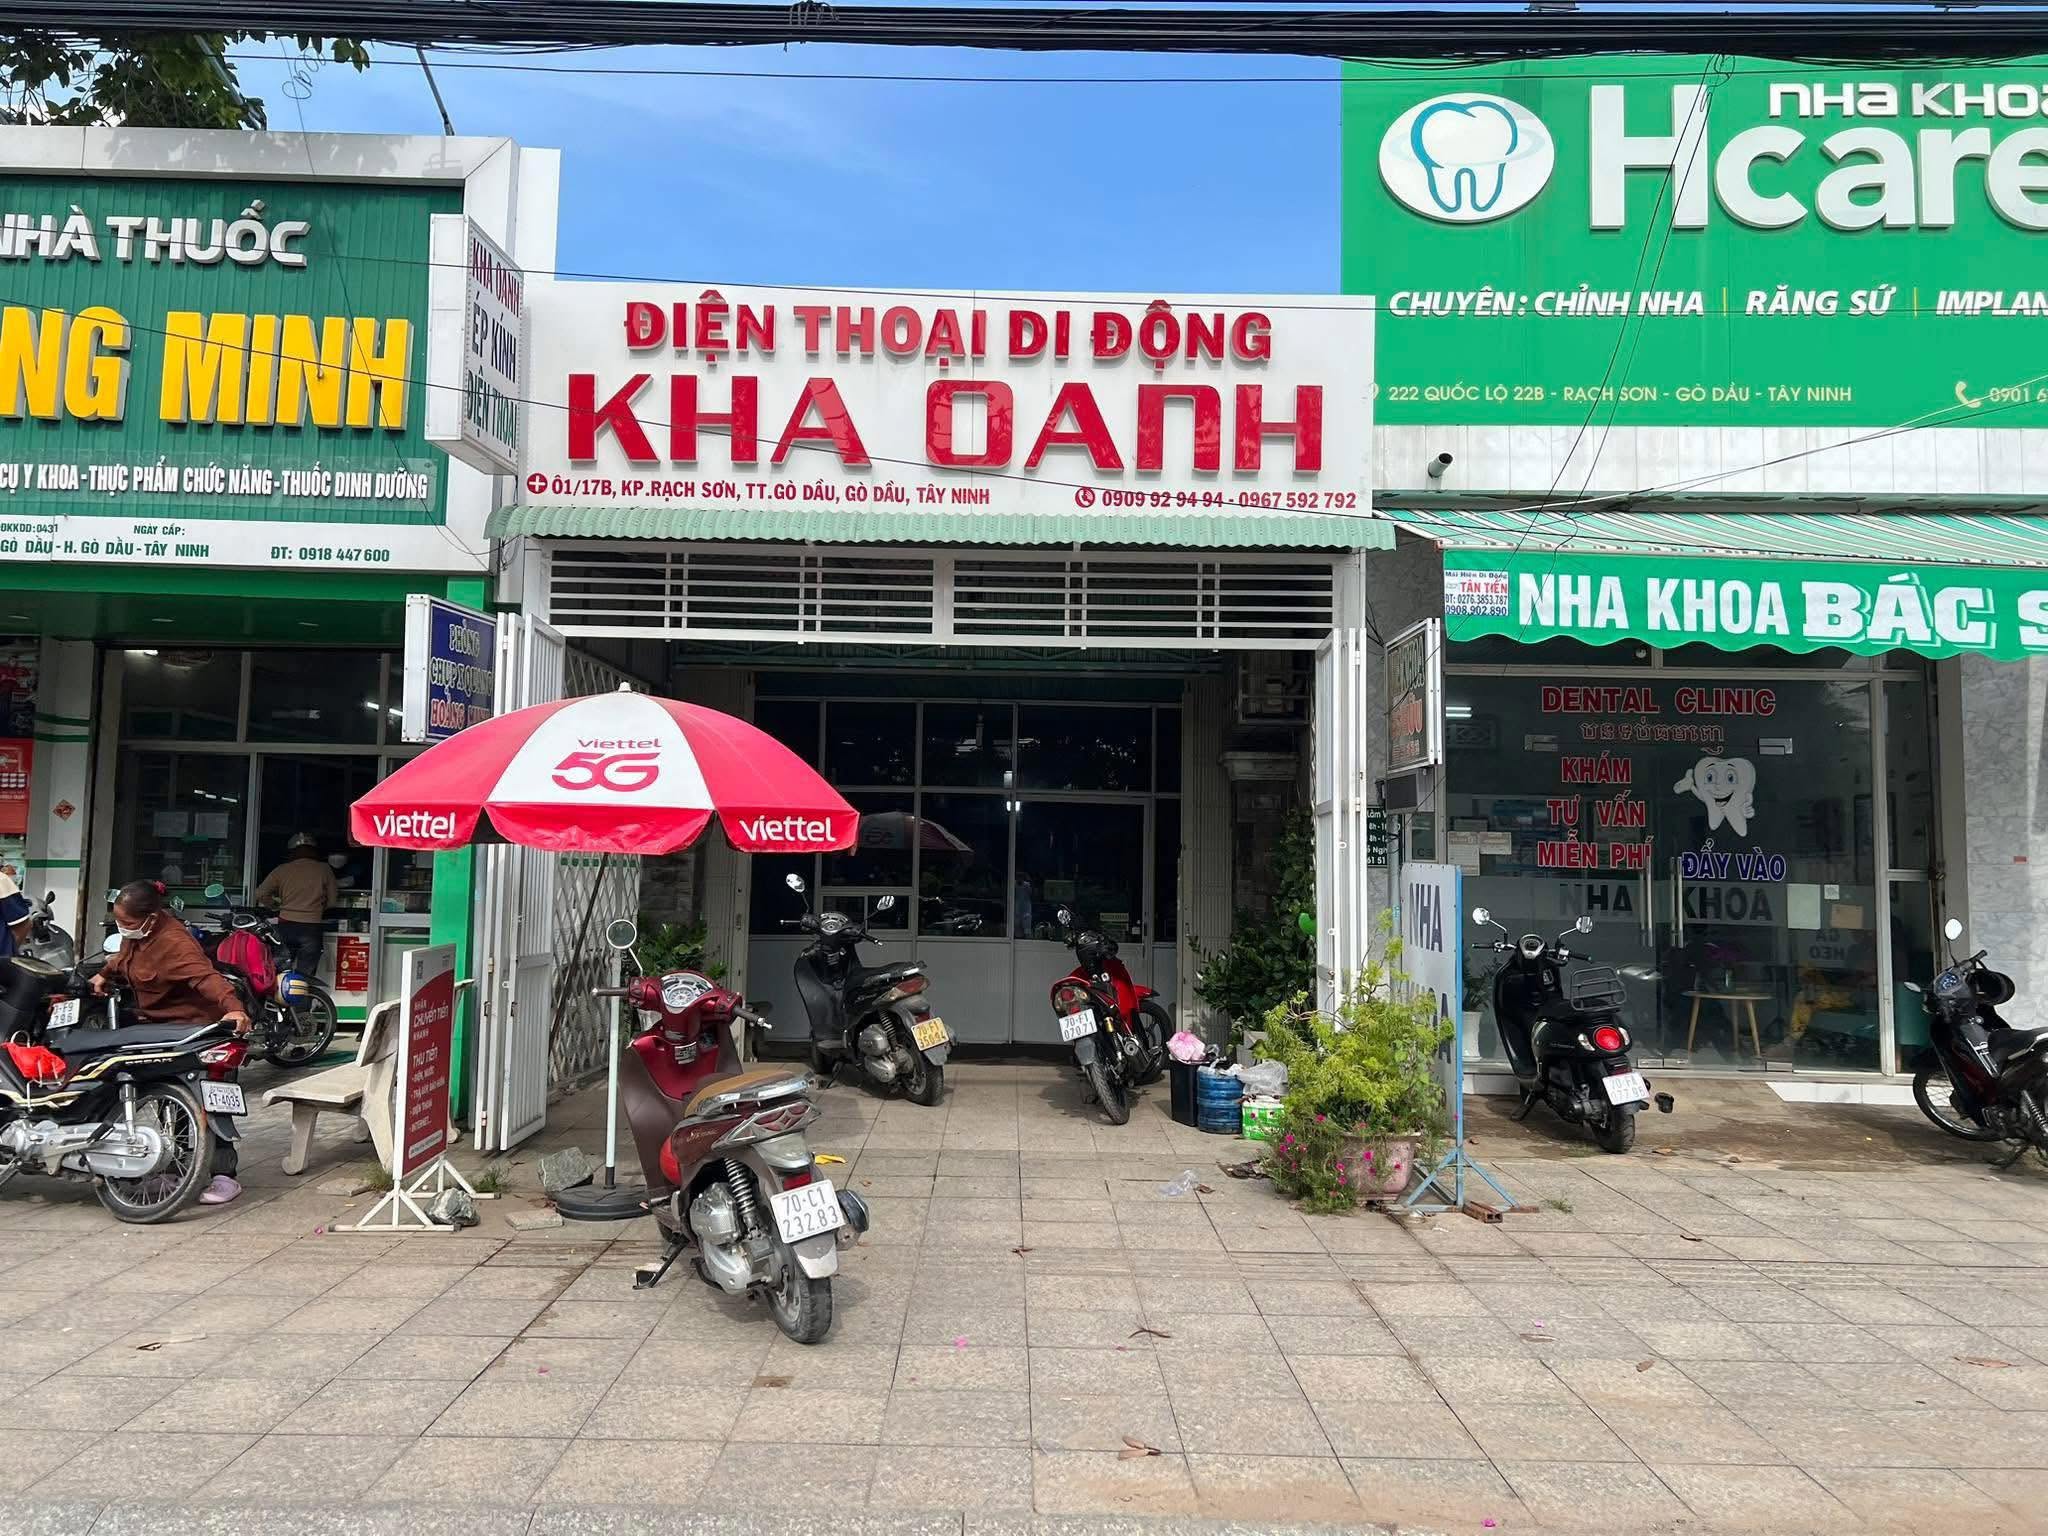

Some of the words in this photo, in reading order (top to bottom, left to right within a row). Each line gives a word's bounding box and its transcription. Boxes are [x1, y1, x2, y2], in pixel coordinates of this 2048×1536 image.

[1589, 84, 2048, 232] Hcare
[106, 199, 312, 267] THUỐC
[471, 237, 493, 294] KHA
[495, 261, 520, 318] OANH
[1534, 282, 1631, 317] CHỈNH
[1637, 290, 1705, 317] NHA
[1744, 284, 1840, 317] RĂNG
[1848, 283, 1898, 317] SỨ
[471, 291, 489, 358] ÉP
[491, 312, 517, 384] KÍNH
[624, 289, 778, 365] ĐIỆN
[794, 305, 986, 367] THOẠI
[1007, 308, 1072, 361] DI
[1089, 298, 1274, 372] ĐỘNG
[160, 310, 414, 431] MINH
[466, 365, 490, 438] ĐIỆN
[492, 388, 518, 458] THOẠI
[1388, 386, 1419, 401] 222
[1424, 381, 1479, 402] QUỐC
[1485, 382, 1508, 404] LỘ
[1513, 386, 1545, 401] 22B
[1564, 386, 1614, 405] RẠCH
[1619, 385, 1657, 402] SƠN
[1675, 383, 1706, 402] GÒ
[1712, 381, 1749, 402] DẦU
[1768, 384, 1802, 402] TÂY
[1807, 386, 1852, 402] NINH
[1990, 387, 2030, 402] 0901
[567, 372, 873, 468] KHA
[23, 463, 34, 489] Y
[133, 455, 179, 492] PHẨM
[183, 462, 225, 494] CHỨC
[334, 471, 372, 498] DINH
[375, 467, 428, 499] DƯỠNG
[701, 479, 741, 502] SƠN,
[803, 478, 840, 504] DẦU,
[845, 480, 868, 502] GÒ
[873, 480, 910, 506] DẦU,
[916, 483, 946, 504] TÂY
[951, 487, 990, 504] NINH
[1102, 490, 1146, 507] 0909
[1150, 491, 1171, 508] 92
[1176, 491, 1198, 507] 94
[1202, 491, 1224, 508] 94
[1238, 491, 1282, 509] 0967
[1286, 491, 1319, 509] 592
[1324, 492, 1357, 509] 792
[1, 537, 18, 553] GÒ
[25, 535, 53, 554] DẦU
[81, 538, 99, 555] GÒ
[105, 536, 134, 556] DẦU
[144, 540, 168, 556] TÂY
[175, 544, 209, 557] NINH
[133, 524, 158, 535] NGÀY
[271, 546, 292, 560] ĐT:
[299, 548, 332, 560] 0918
[1460, 579, 1481, 592] TÂN
[1518, 573, 1629, 630] NHA
[1647, 576, 1791, 637] KHOA
[1801, 572, 1997, 648] BÁC
[1542, 686, 1660, 714] DENTAL
[1675, 687, 1776, 716] CLINIC
[577, 738, 663, 749] viettel
[551, 751, 660, 793] 5G
[1561, 751, 1632, 784] KHÁM
[373, 809, 456, 840] viettel
[1546, 794, 1581, 826] TƯ
[1596, 790, 1646, 827] VẤN
[738, 814, 835, 843] viettel
[1537, 829, 1599, 869] MIỄN
[1609, 835, 1655, 869] PHÍ
[1681, 838, 1732, 879] ĐẨY
[1735, 847, 1787, 881] VÀO
[1409, 882, 1443, 953] NHA
